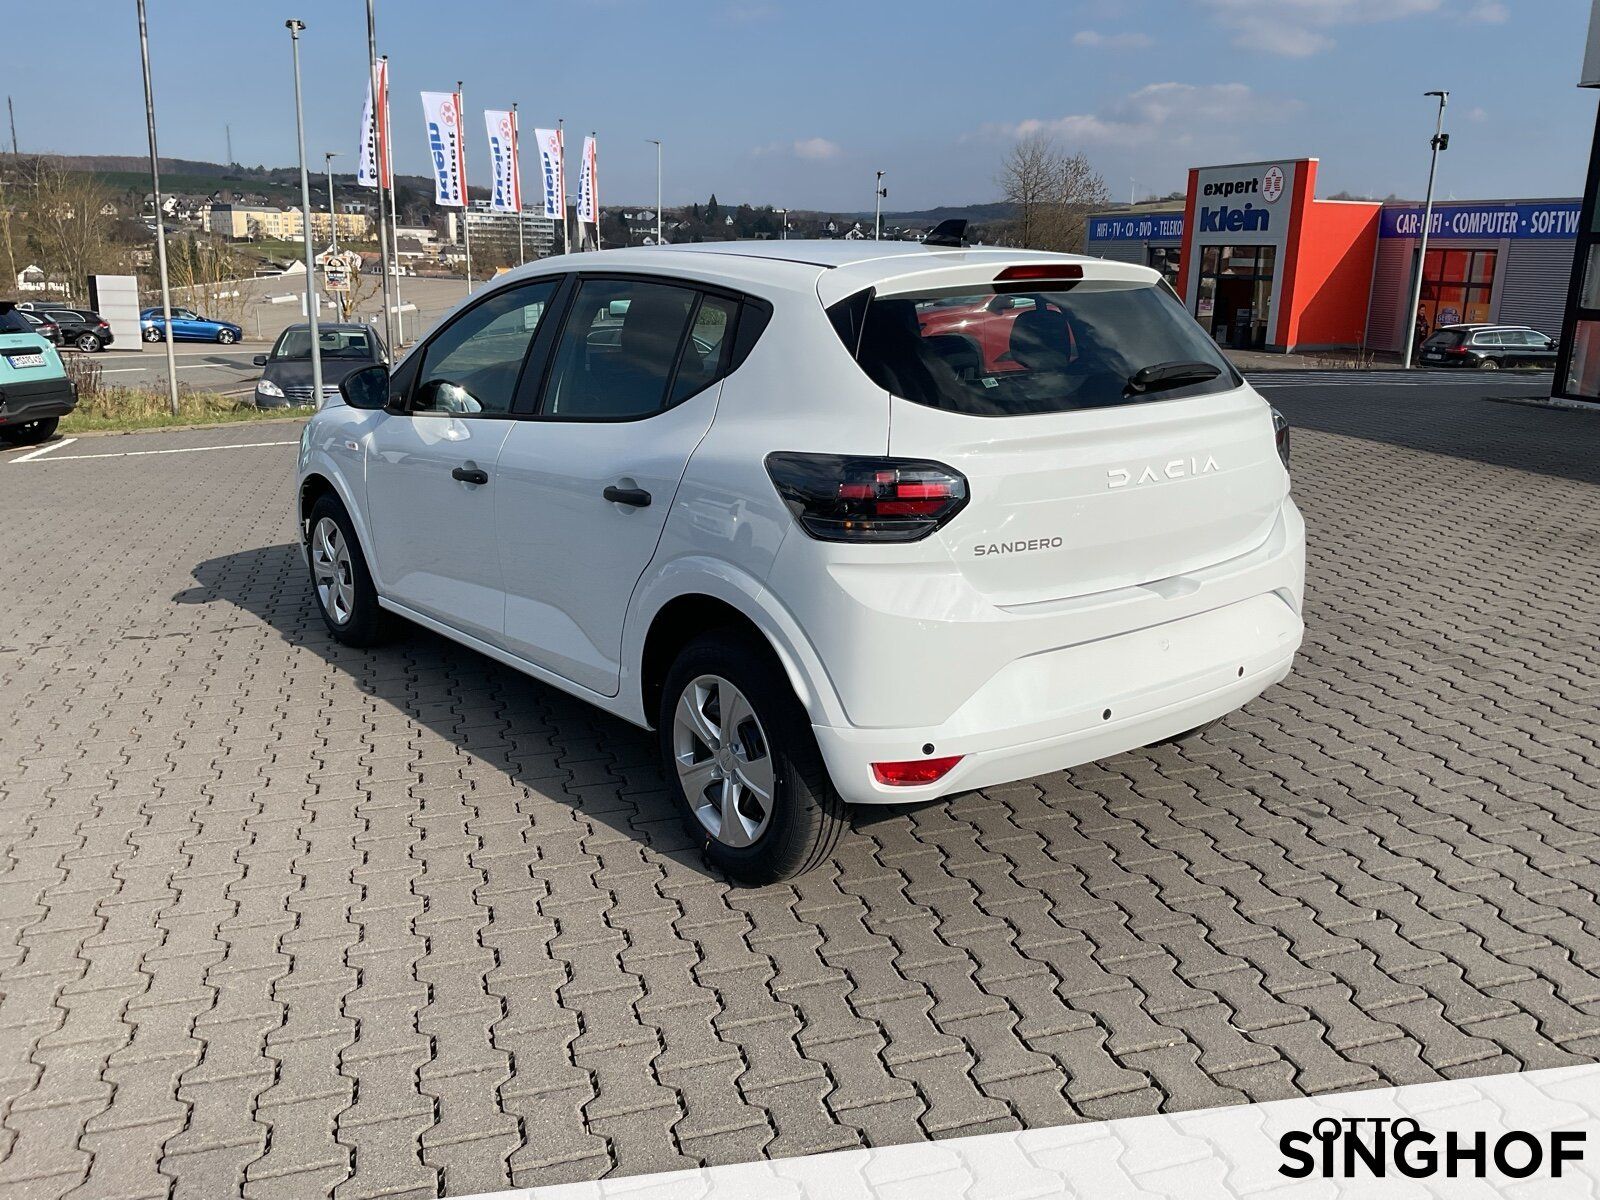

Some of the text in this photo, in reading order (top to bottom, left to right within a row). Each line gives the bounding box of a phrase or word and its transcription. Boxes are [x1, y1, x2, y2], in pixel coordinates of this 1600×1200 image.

[428, 122, 450, 200] klein
[447, 132, 458, 201] expert
[491, 136, 504, 207] klein
[543, 151, 555, 214] klein
[1203, 178, 1258, 198] expert
[1113, 222, 1121, 237] TV
[1126, 222, 1134, 237] CD
[1139, 221, 1152, 237] DVD
[1160, 220, 1184, 236] TELEKO
[1200, 203, 1269, 231] klein
[1452, 212, 1519, 234] COMPUTER
[1530, 210, 1581, 234] SOFTW
[1107, 455, 1220, 489] DACIA
[974, 536, 1063, 556] SANDERO
